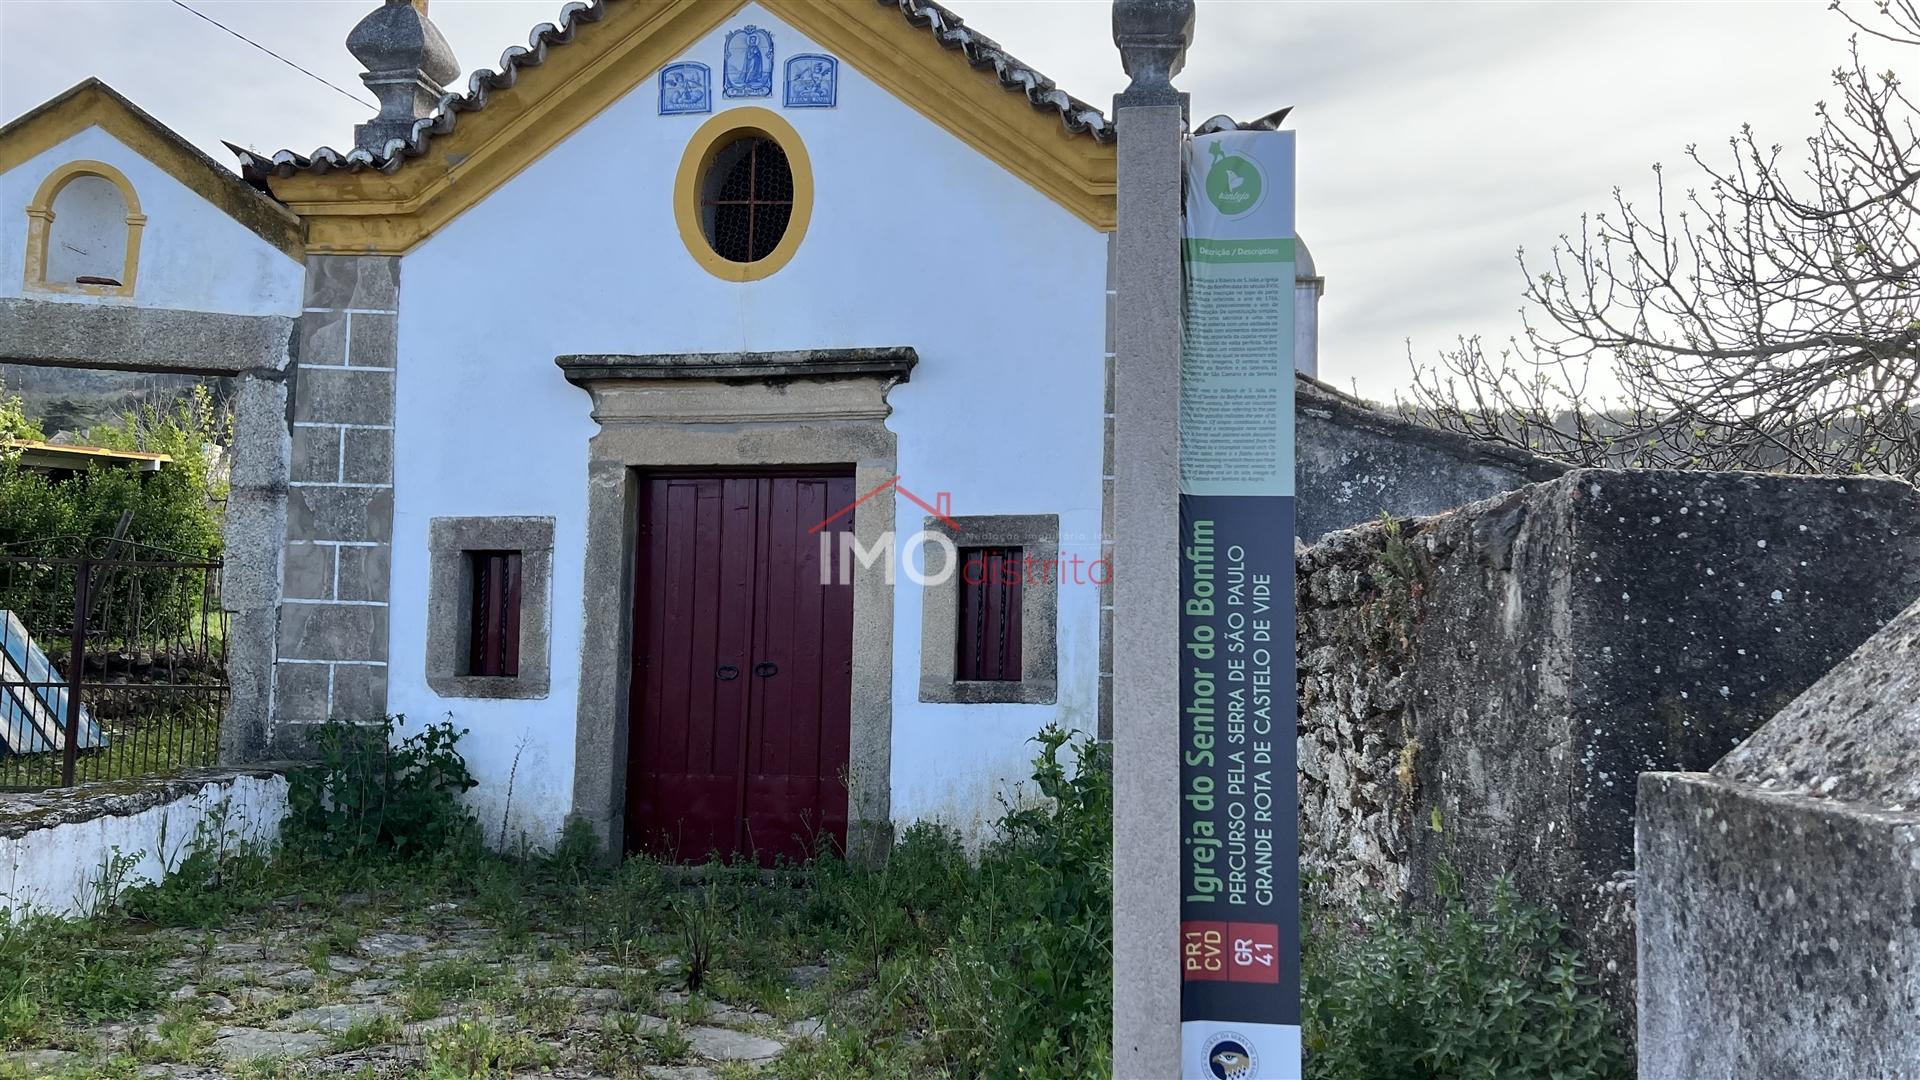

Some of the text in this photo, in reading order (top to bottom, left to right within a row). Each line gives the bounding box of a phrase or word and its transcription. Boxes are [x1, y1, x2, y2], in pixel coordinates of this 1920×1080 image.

[1237, 247, 1279, 256] Description
[1185, 520, 1223, 902] Igreja do Senhor do Bonfim
[1224, 545, 1246, 904] PERCURSO PELA SERRA DE SÃO PAULO
[1253, 574, 1273, 906] GRANDE ROTA DE CASTELO DE VIDE
[1185, 931, 1202, 971] PR1
[1204, 930, 1221, 971] CVD
[1234, 938, 1253, 966] GR
[1255, 943, 1274, 967] 41
